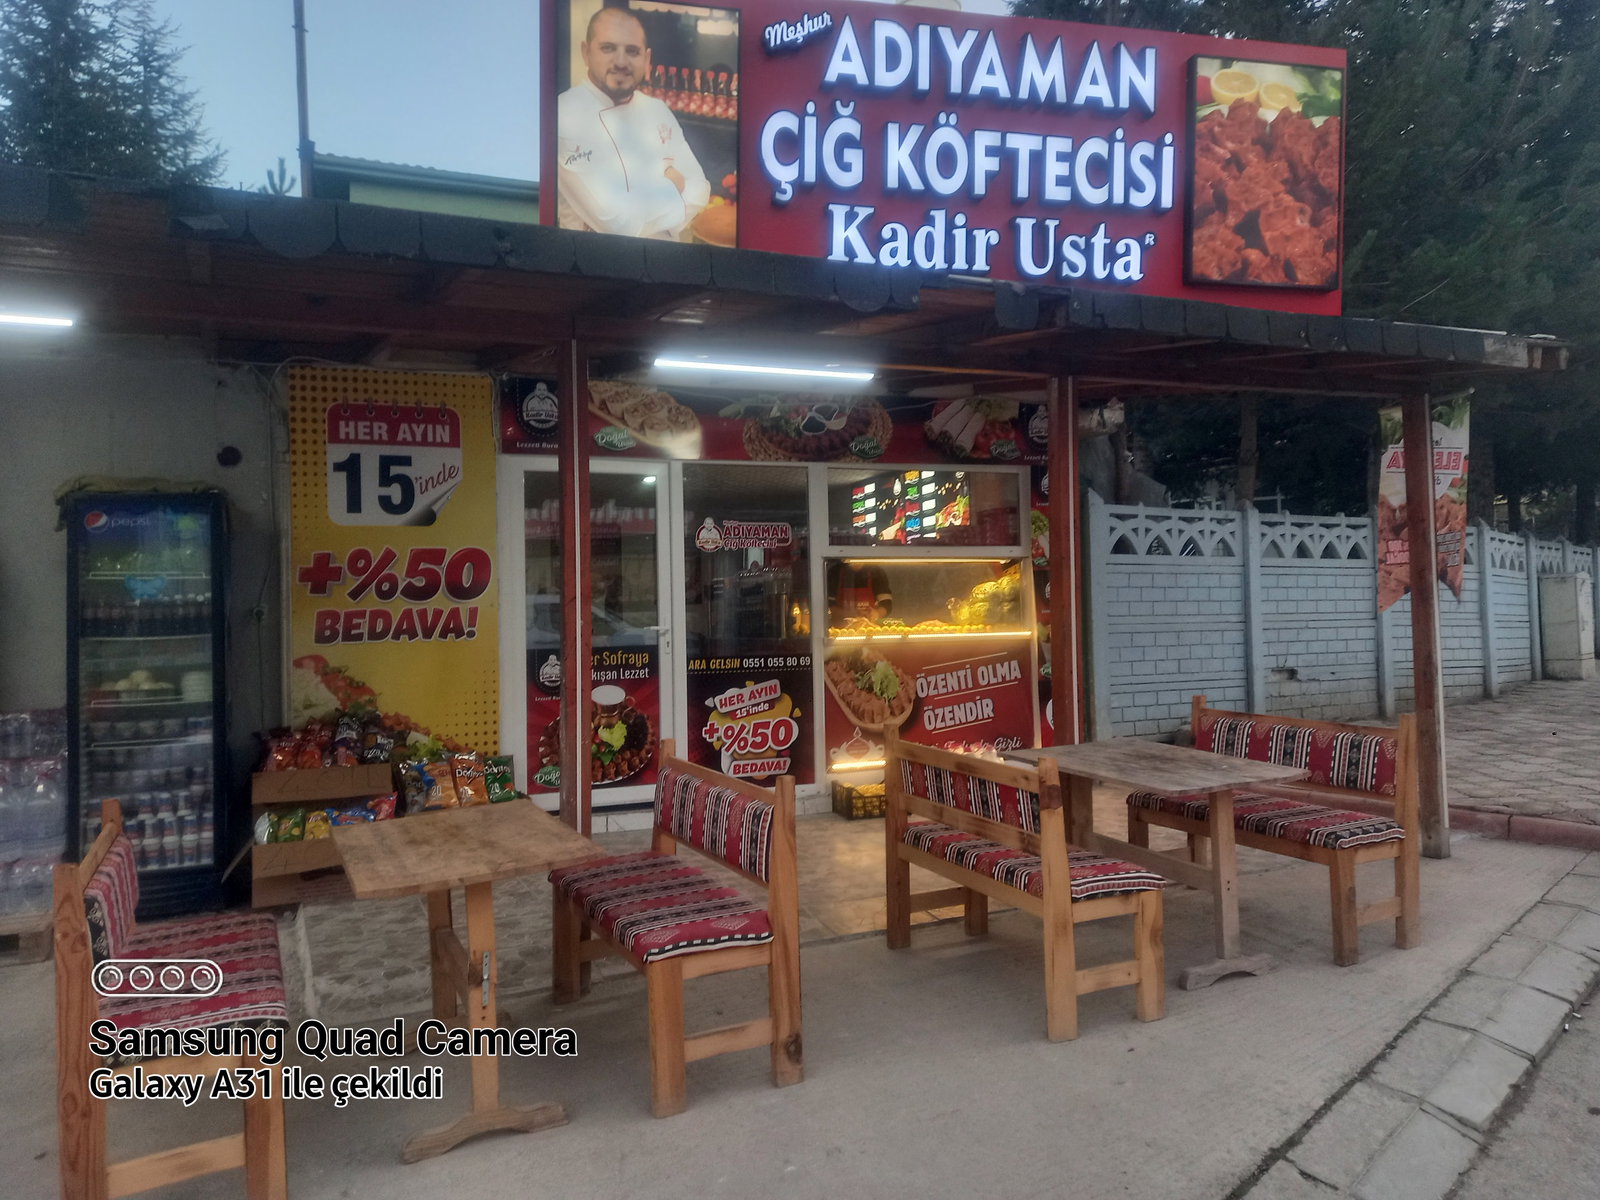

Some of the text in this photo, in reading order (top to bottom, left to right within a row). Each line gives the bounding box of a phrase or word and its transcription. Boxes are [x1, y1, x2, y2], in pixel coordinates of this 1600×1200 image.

[764, 11, 832, 42] Meşhur
[823, 15, 1156, 112] ADIYAMAN
[761, 100, 1174, 208] ÇİĞ KÖFTECİSİ
[827, 203, 999, 271] Kadir
[1015, 217, 1144, 280] Usta
[339, 421, 450, 443] HER AYIN
[111, 516, 150, 528] pepsi
[724, 525, 789, 538] ADIYAMAN
[314, 606, 479, 644] BEDAVA!
[603, 651, 649, 667] Sofraya
[688, 659, 706, 670] ARA
[743, 658, 764, 668] 0551
[767, 657, 784, 667] 055
[786, 657, 798, 667] 80
[800, 656, 811, 666] 69
[620, 668, 649, 679] Lezzet
[916, 664, 973, 698] ÖZENTİ
[977, 660, 1022, 686] OLMA
[719, 684, 778, 709] HER AYIN
[735, 702, 770, 719] 15'inde
[923, 696, 995, 731] ÖZENDİR
[994, 736, 1023, 753] Gizli
[732, 760, 788, 775] BEDAVA!
[534, 770, 561, 785] Doğa
